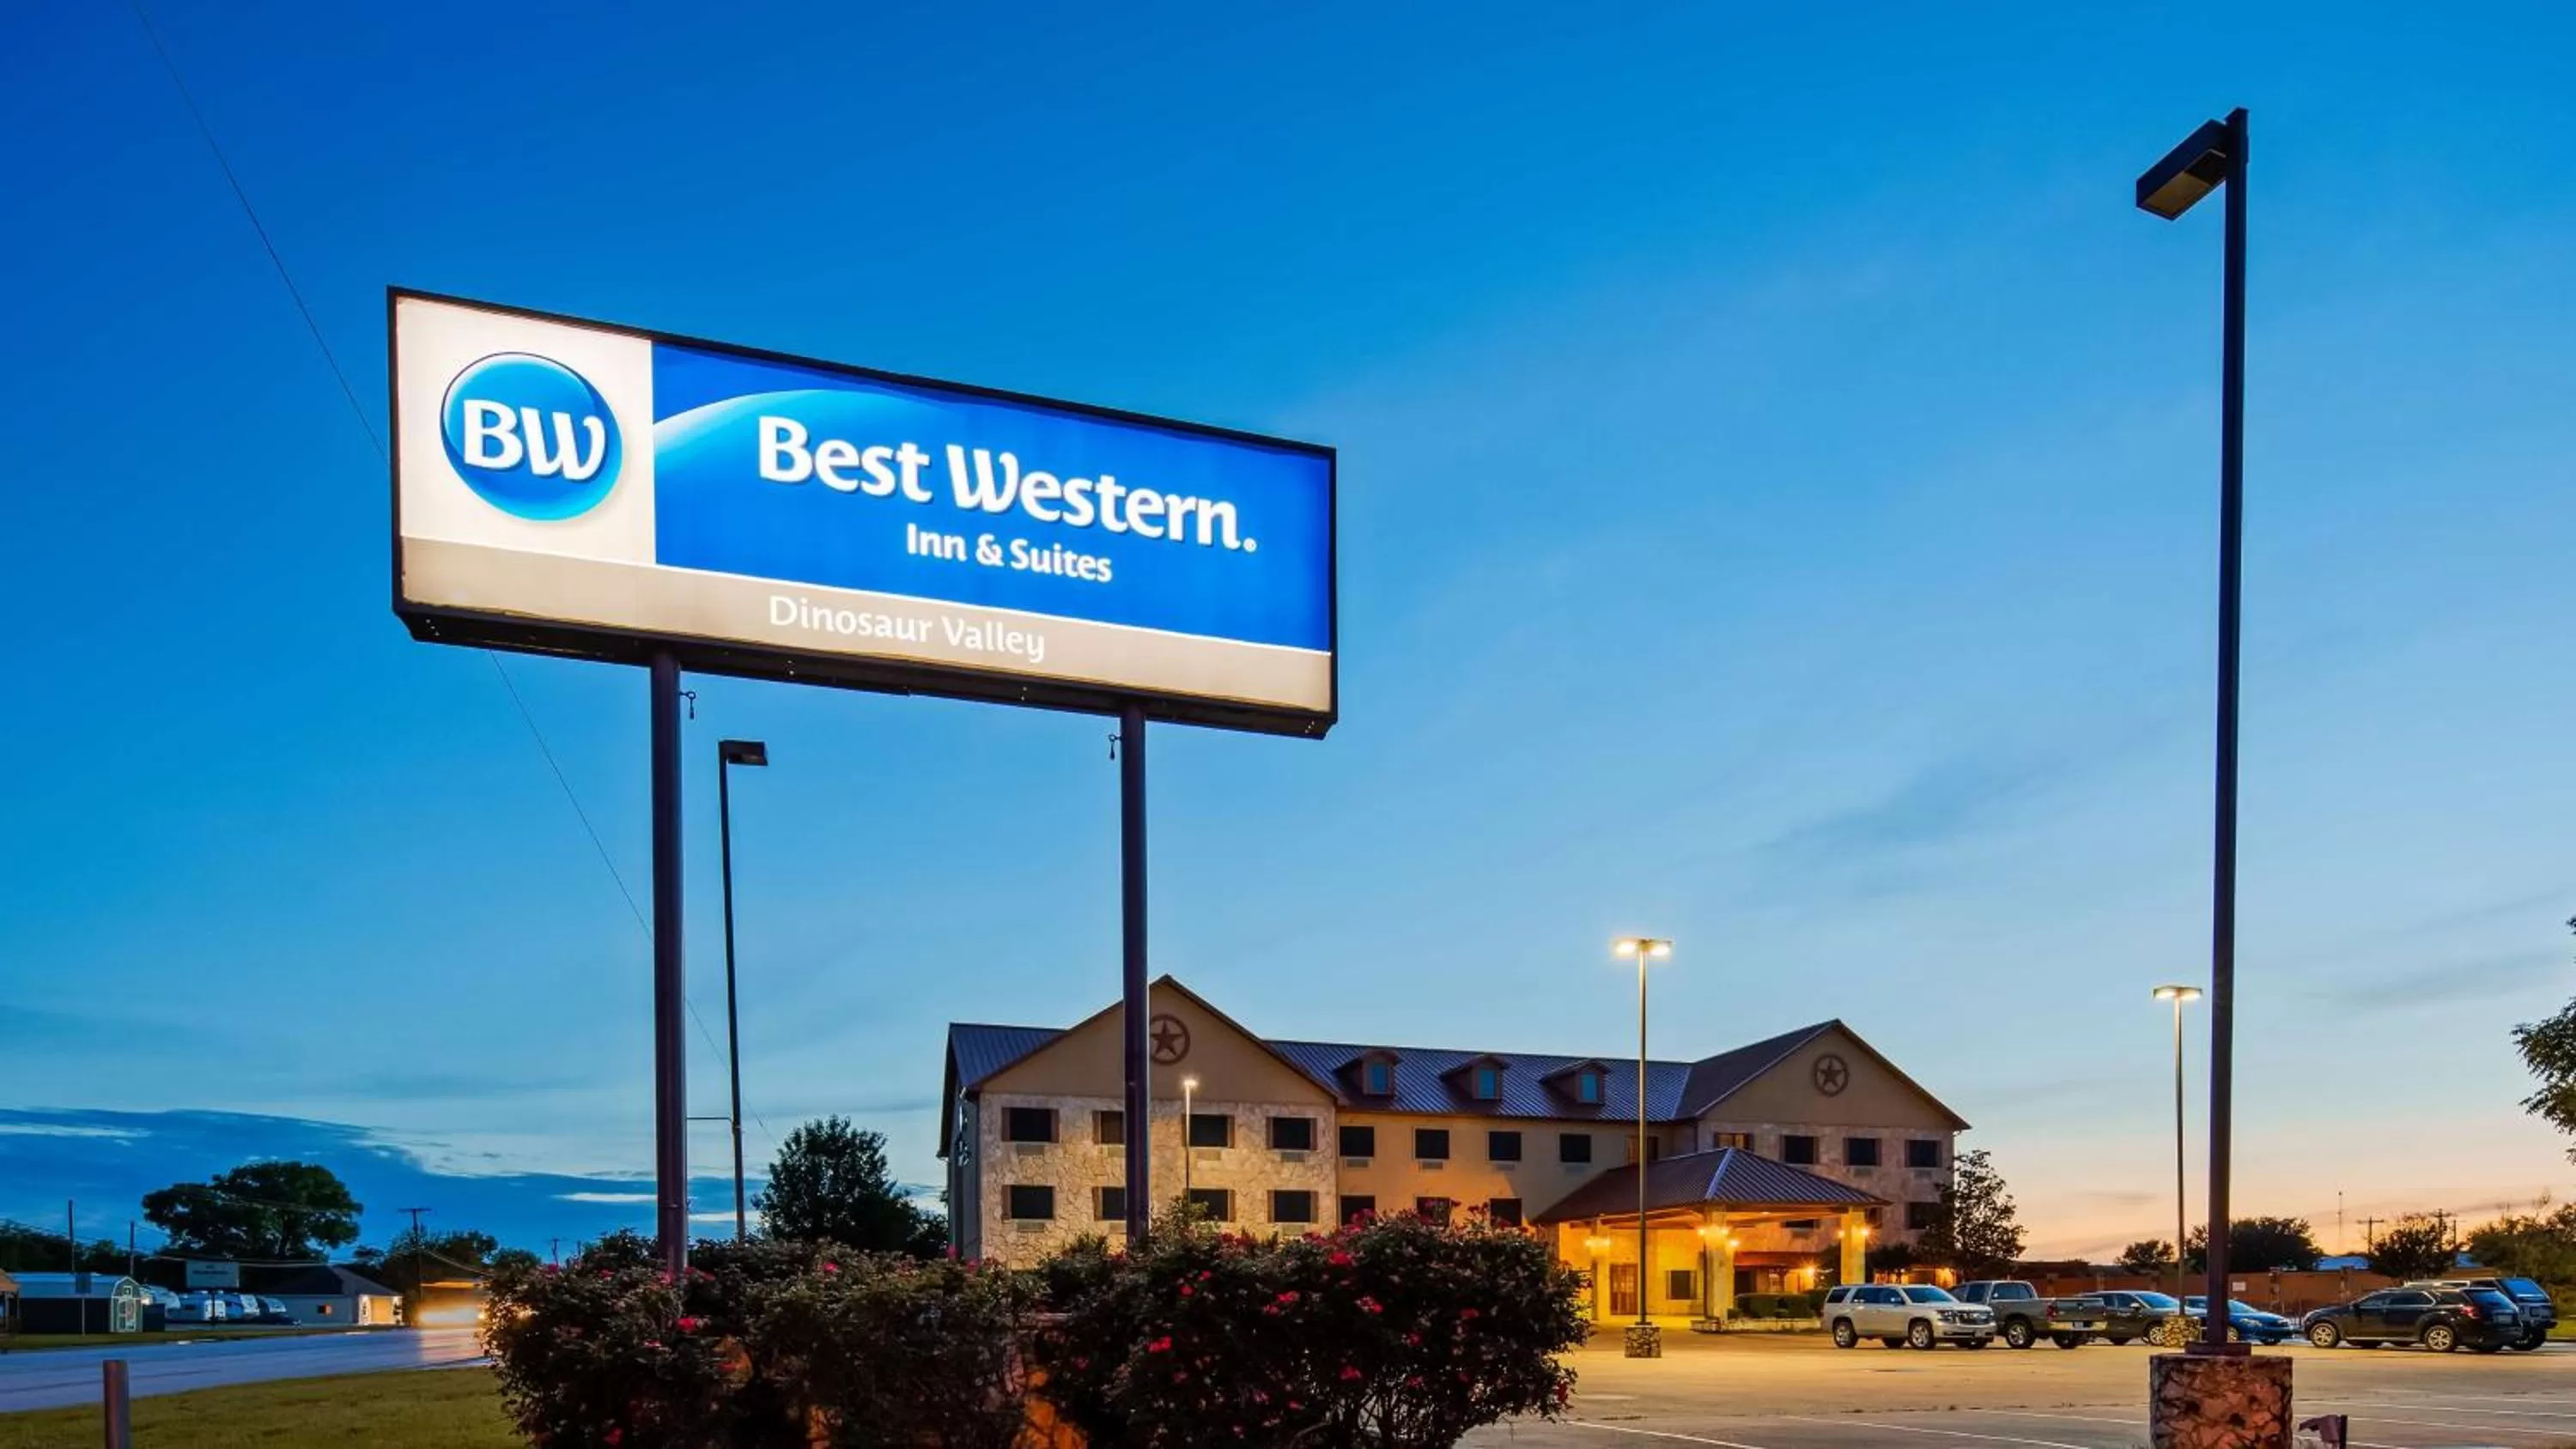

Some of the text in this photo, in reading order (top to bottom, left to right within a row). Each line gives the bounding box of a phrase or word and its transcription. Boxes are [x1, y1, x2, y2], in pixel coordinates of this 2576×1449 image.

[463, 398, 606, 481] BW
[758, 415, 933, 503] Best
[906, 522, 1113, 583] Inn & Suites
[769, 595, 1045, 664] Dinosaur Valley
